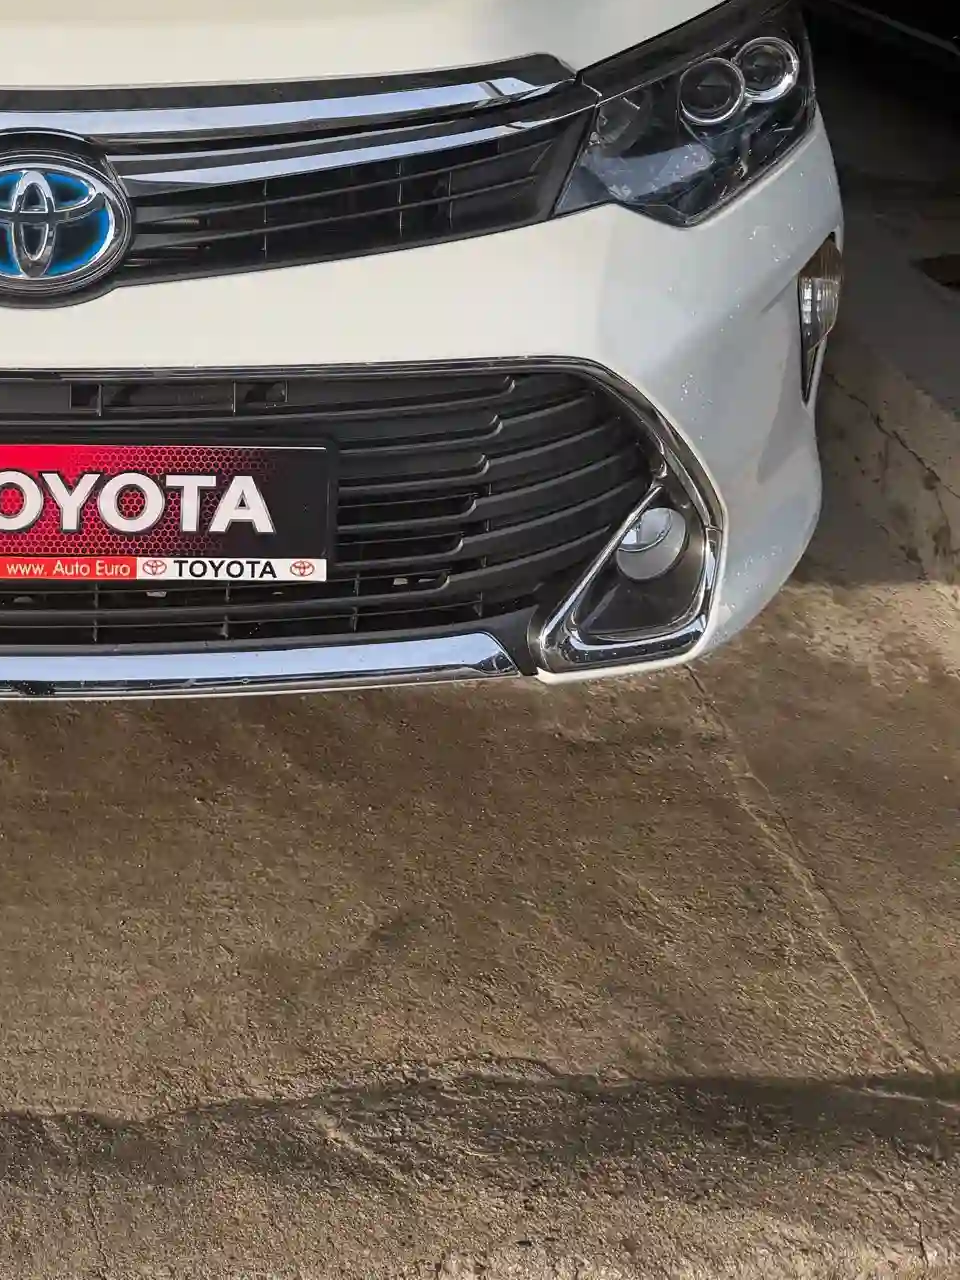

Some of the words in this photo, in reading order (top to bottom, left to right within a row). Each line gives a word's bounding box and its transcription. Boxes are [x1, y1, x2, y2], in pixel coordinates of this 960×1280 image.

[6, 563, 48, 575] www.
[53, 559, 91, 577] Auto
[95, 560, 131, 577] Euro
[173, 559, 278, 579] TOYOTA
